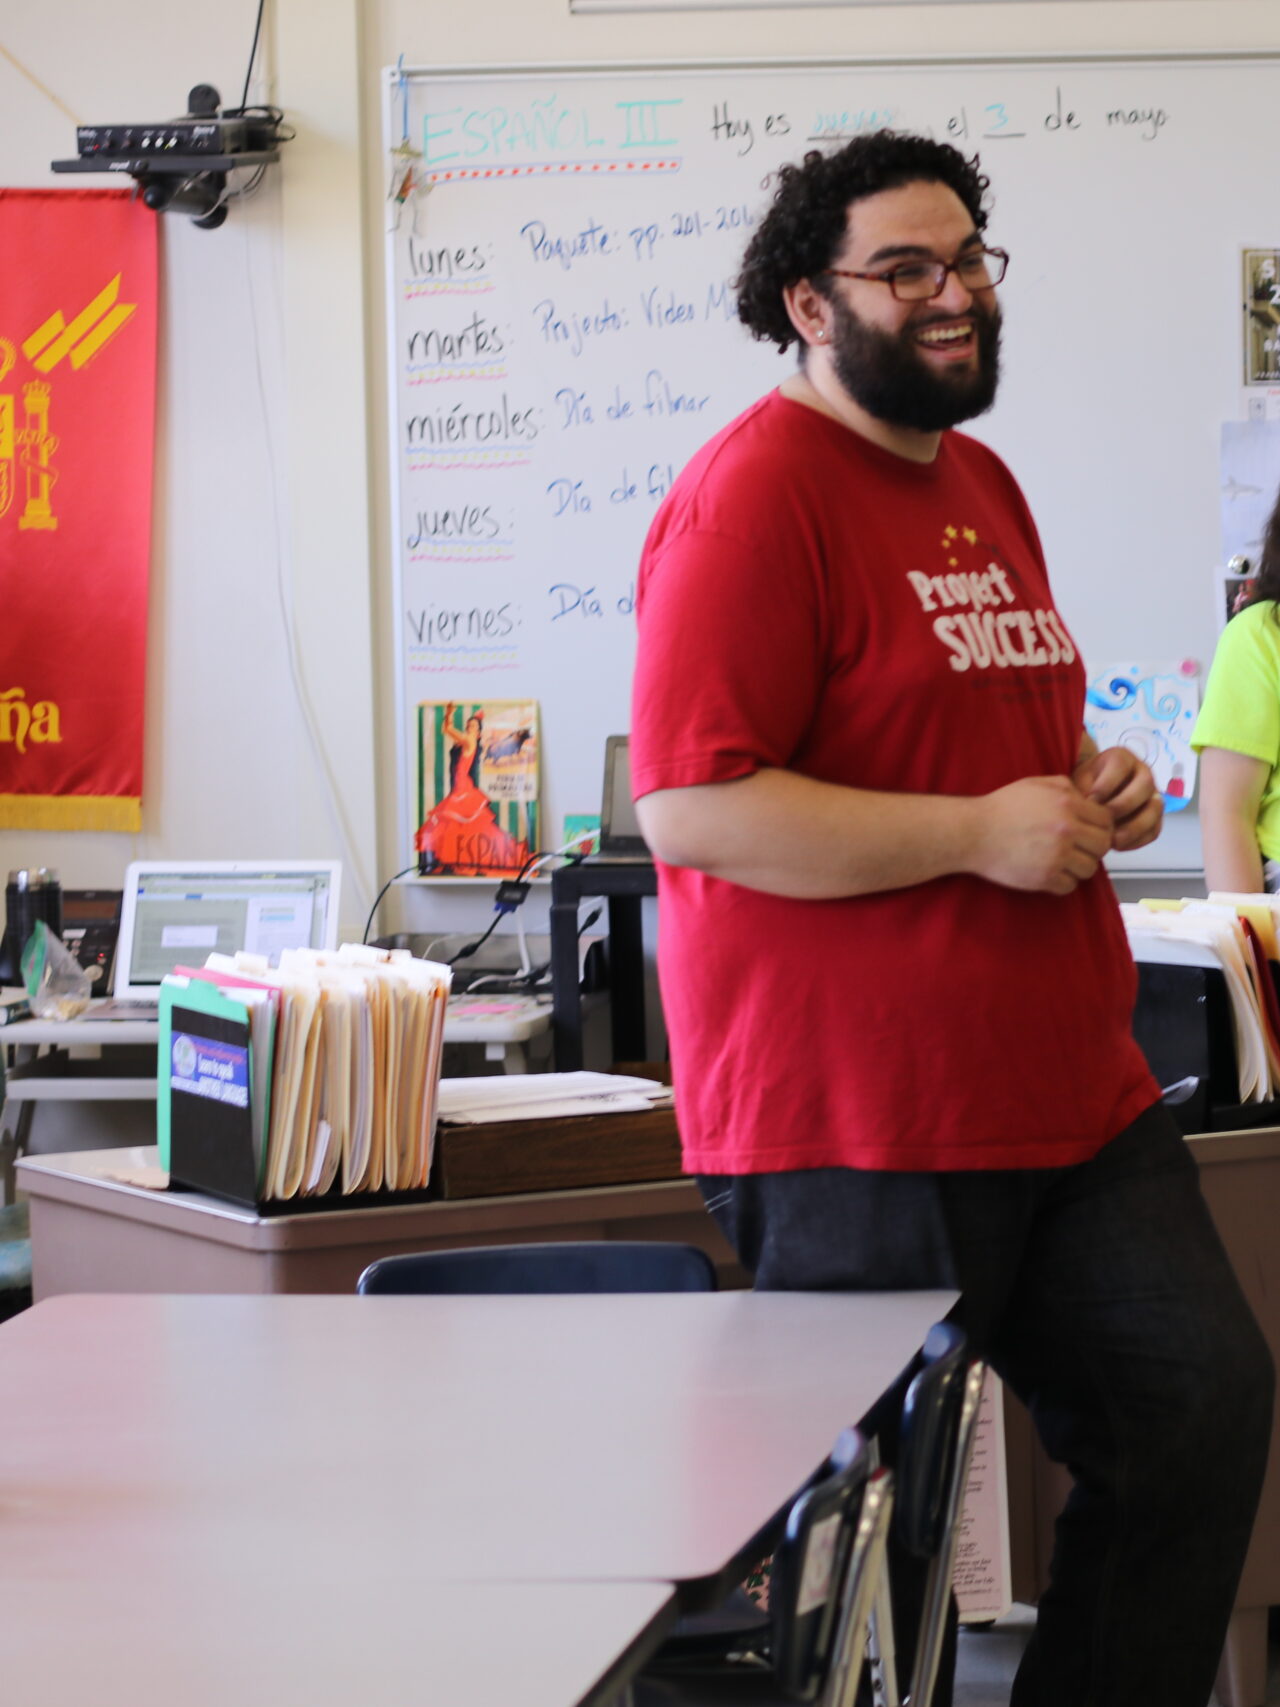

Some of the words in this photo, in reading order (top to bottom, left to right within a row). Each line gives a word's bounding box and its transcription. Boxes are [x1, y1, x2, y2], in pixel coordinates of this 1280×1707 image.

[424, 92, 606, 164] ESPAÑOL
[615, 98, 684, 148] III
[712, 101, 754, 157] Hoy
[766, 113, 791, 135] es
[947, 106, 968, 139] el
[985, 103, 1009, 131] 3
[1045, 86, 1081, 131] de
[1106, 108, 1168, 141] mayo
[555, 387, 594, 430] Día
[607, 386, 631, 420] de
[547, 478, 591, 518] Día
[610, 467, 636, 505] de
[549, 583, 604, 622] Día
[906, 562, 1015, 612] Project
[933, 608, 1074, 672] SUCCESS
